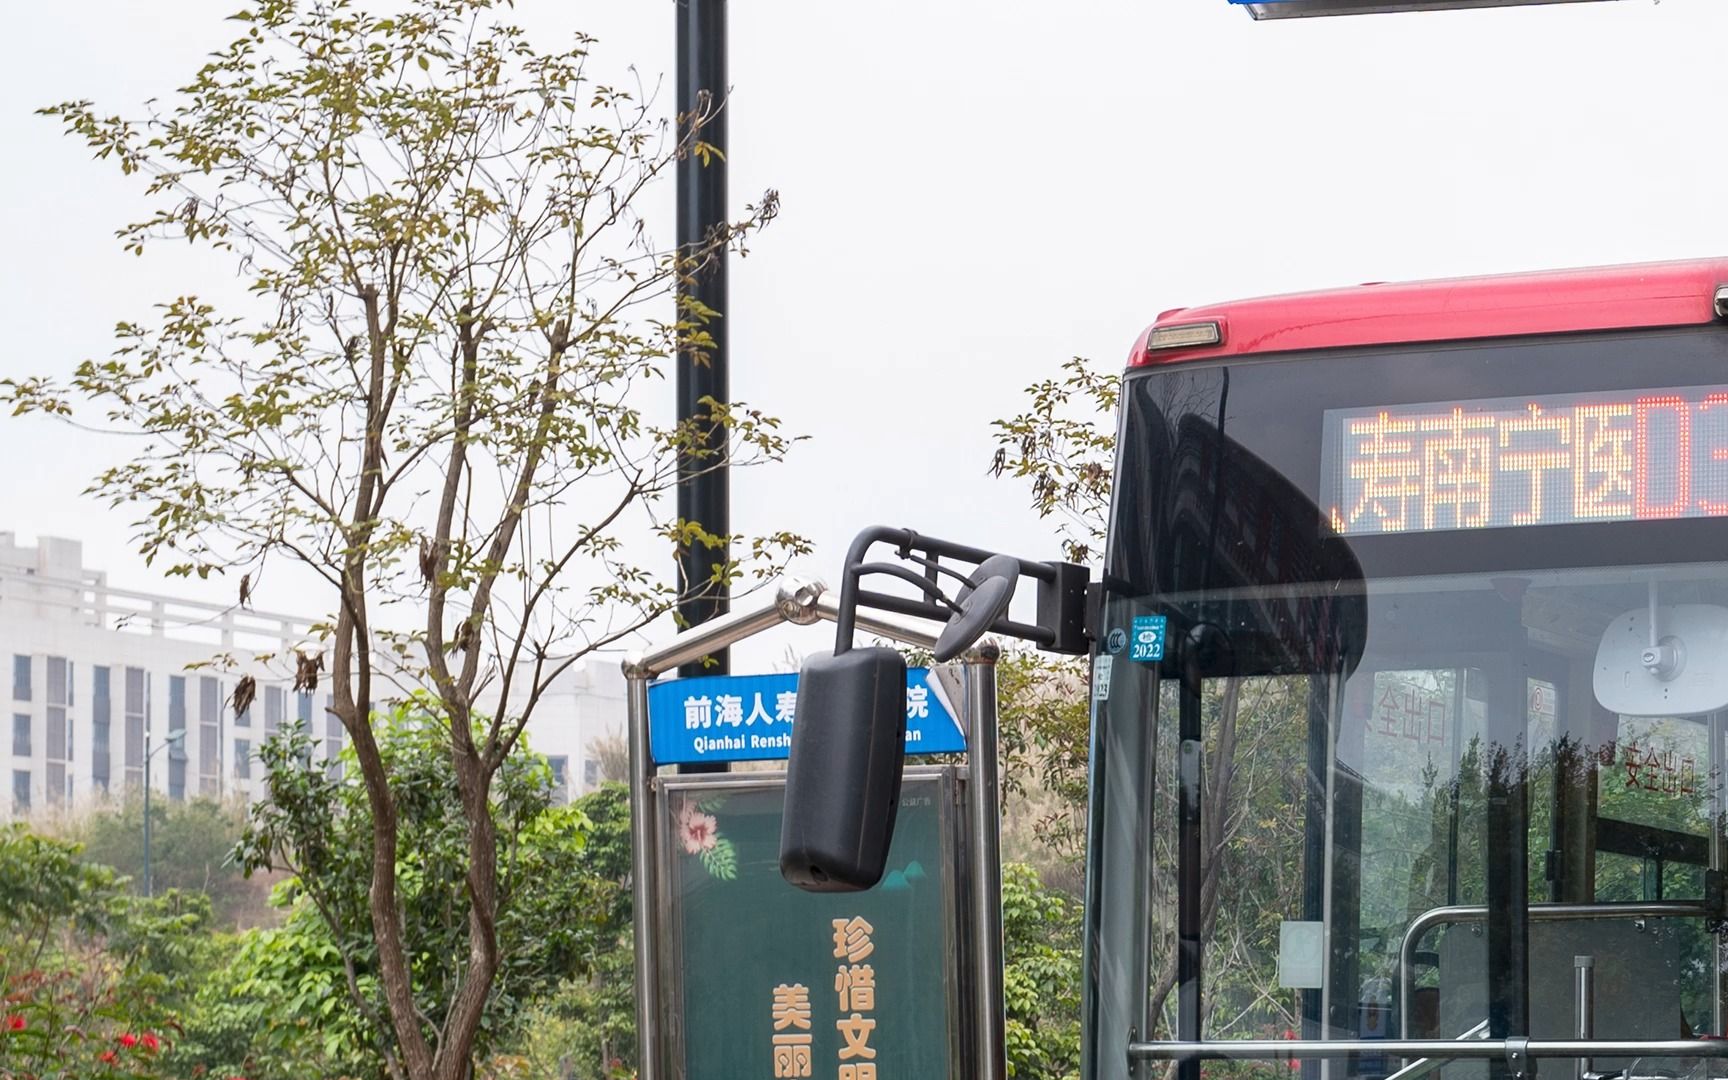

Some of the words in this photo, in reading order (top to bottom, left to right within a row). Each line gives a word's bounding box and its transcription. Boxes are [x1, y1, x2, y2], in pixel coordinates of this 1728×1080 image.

[1332, 405, 1632, 533] 寿南宁医
[1133, 643, 1160, 658] 2022
[694, 734, 746, 754] Qianhai
[751, 733, 791, 749] Rensh
[1365, 686, 1446, 746] 全出口
[1625, 741, 1696, 797] 安全出口
